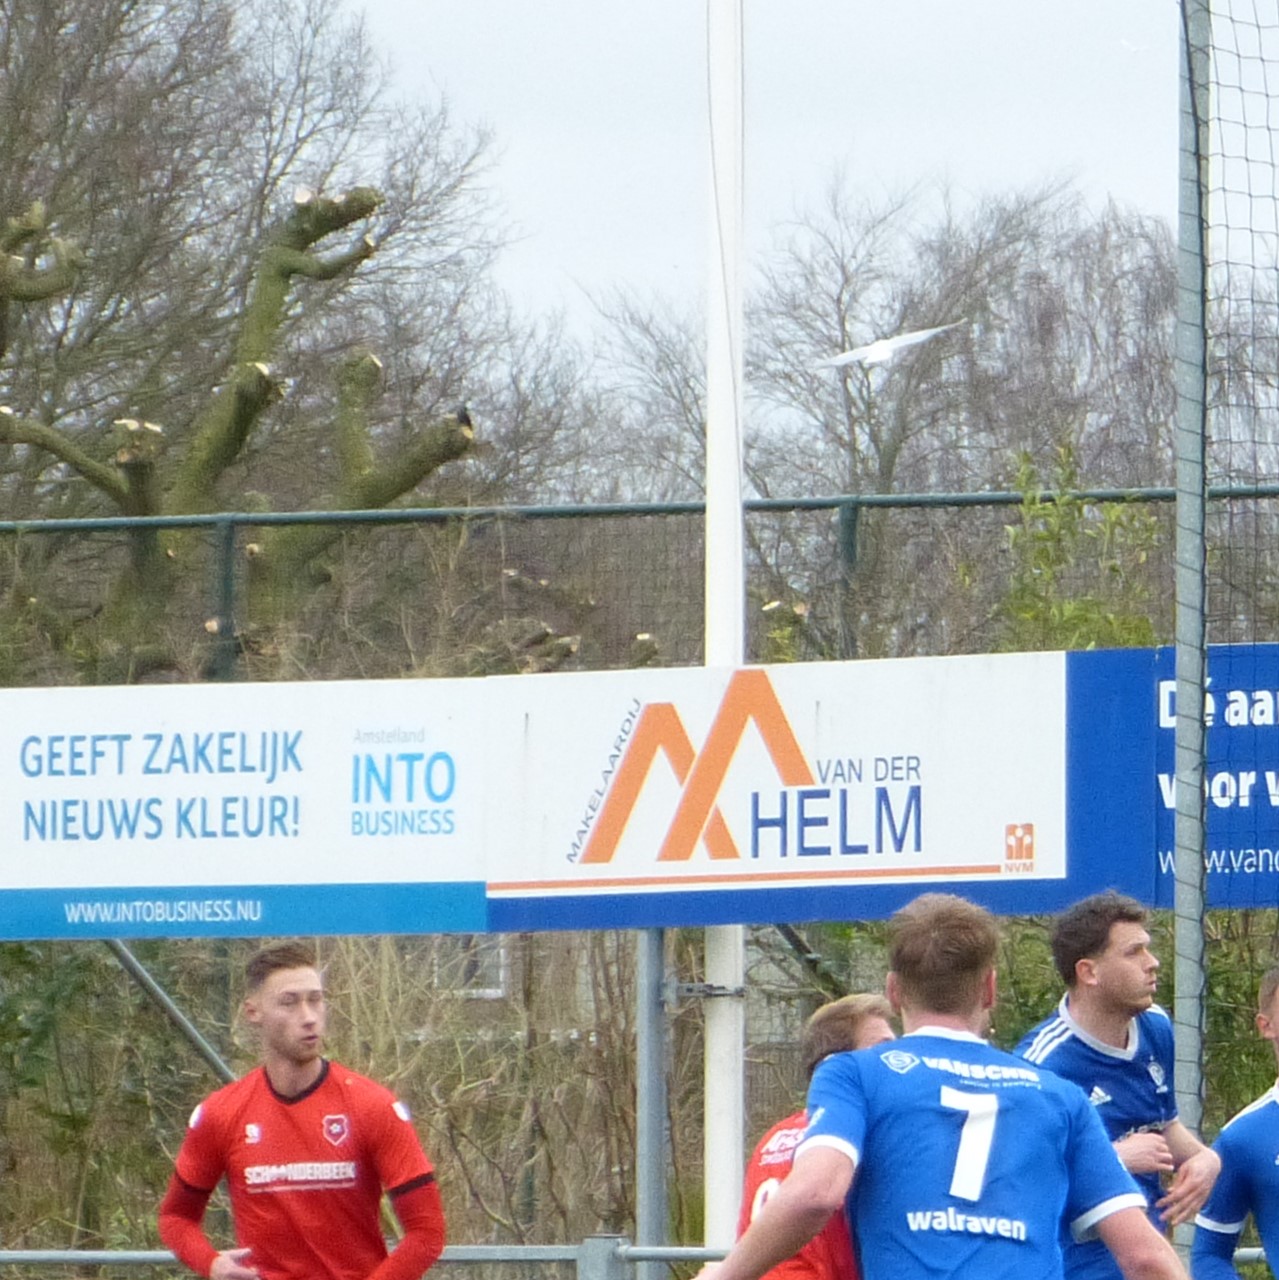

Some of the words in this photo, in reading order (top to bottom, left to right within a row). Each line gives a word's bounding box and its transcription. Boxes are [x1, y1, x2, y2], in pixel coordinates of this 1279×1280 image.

[353, 727, 426, 744] Amstelland
[20, 733, 132, 778] GEEFT
[142, 730, 304, 784] ZAKELIJK
[816, 759, 863, 784] VAN
[874, 756, 921, 782] DER
[352, 751, 457, 804] INTO
[566, 697, 642, 864] MAKELAARDIJ
[1158, 770, 1256, 809] vor
[24, 798, 164, 841] NIEUWS
[176, 796, 301, 839] KLEUR!
[351, 810, 455, 836] BUSINESS
[751, 785, 922, 859] HELM
[1005, 862, 1034, 873] NVM
[64, 901, 262, 924] WWW.INTOBUSINESS.NU
[940, 1085, 998, 1202] 7
[907, 1207, 1027, 1241] walraven
